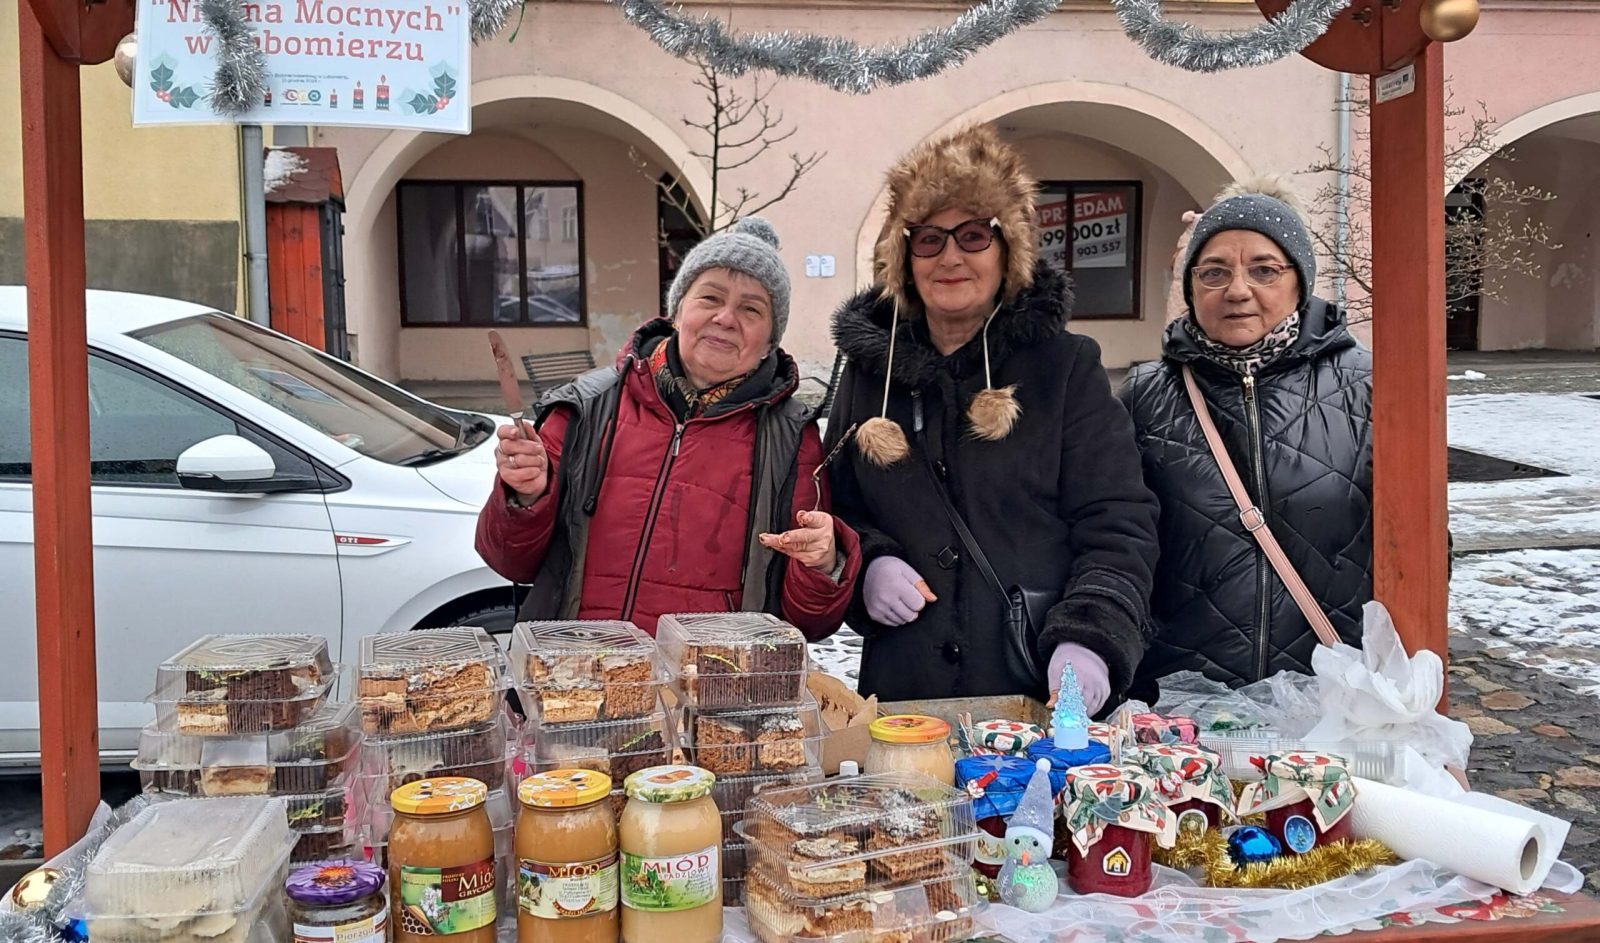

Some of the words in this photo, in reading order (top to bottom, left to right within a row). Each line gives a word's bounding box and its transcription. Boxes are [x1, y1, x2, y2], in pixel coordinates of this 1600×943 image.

[152, 0, 201, 22] "Ni
[294, 0, 460, 34] Mocnych"
[184, 35, 213, 55] w
[254, 29, 424, 61] bomierzu
[1041, 196, 1123, 223] PREDAM
[1105, 217, 1121, 236] zł
[1076, 245, 1098, 257] 903
[1101, 241, 1121, 253] 557
[643, 855, 709, 874] MIÓD
